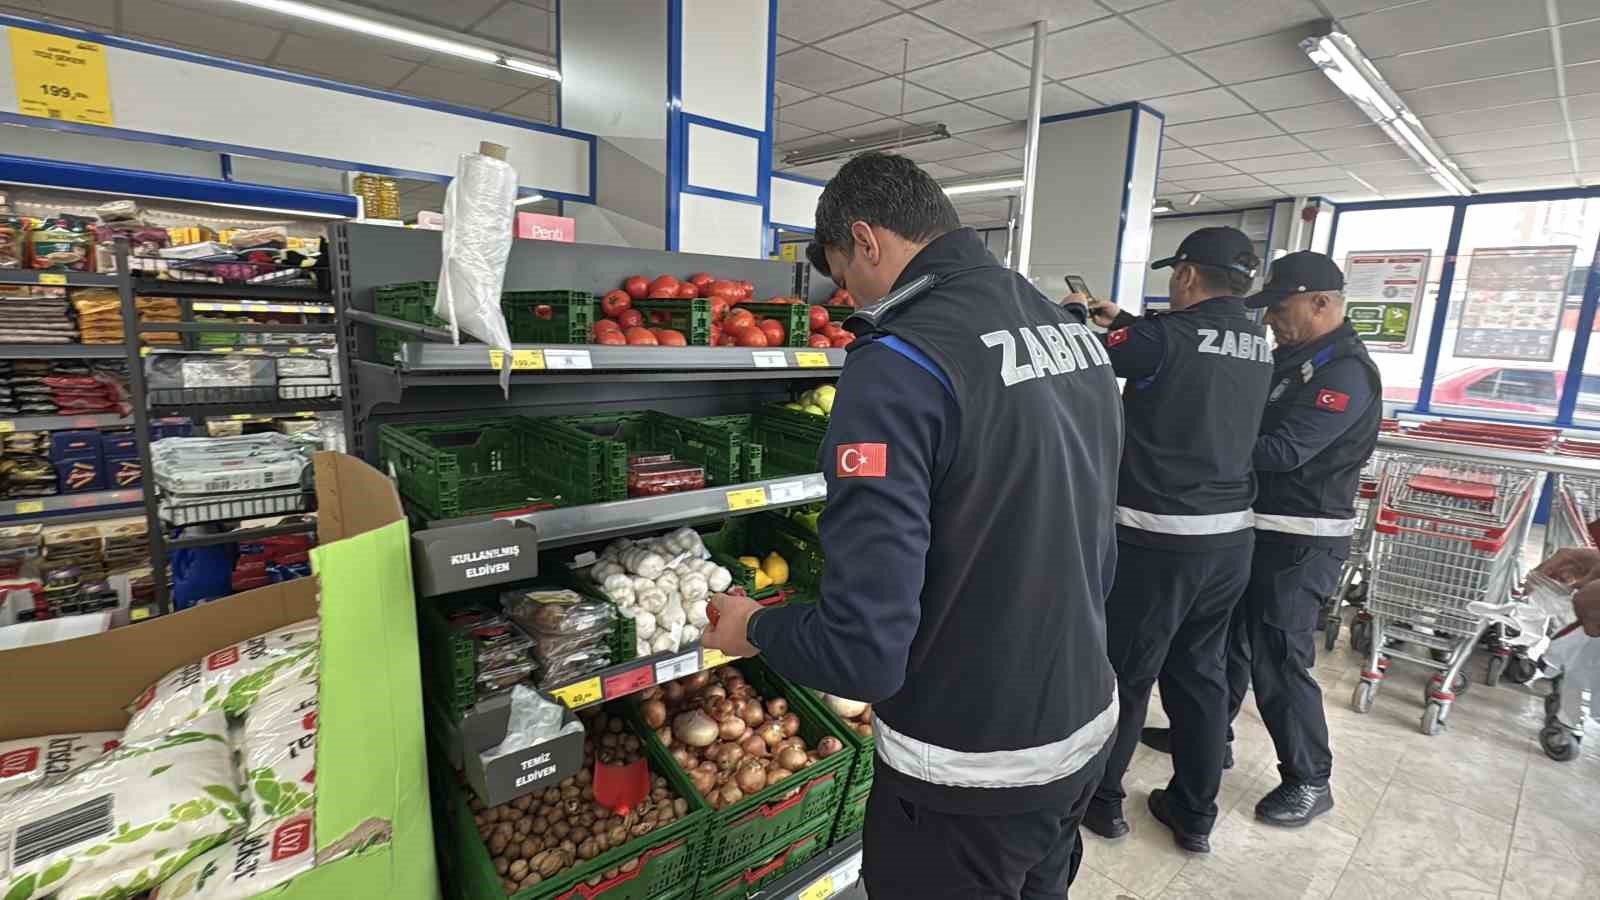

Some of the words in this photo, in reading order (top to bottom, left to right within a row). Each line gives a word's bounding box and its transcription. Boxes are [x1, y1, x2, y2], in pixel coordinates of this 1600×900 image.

[451, 544, 520, 565] KULLANILMIŞ
[465, 561, 510, 578] ELDİVEN
[520, 752, 551, 770] TEMİZ
[515, 764, 556, 787] ELDİVEN
